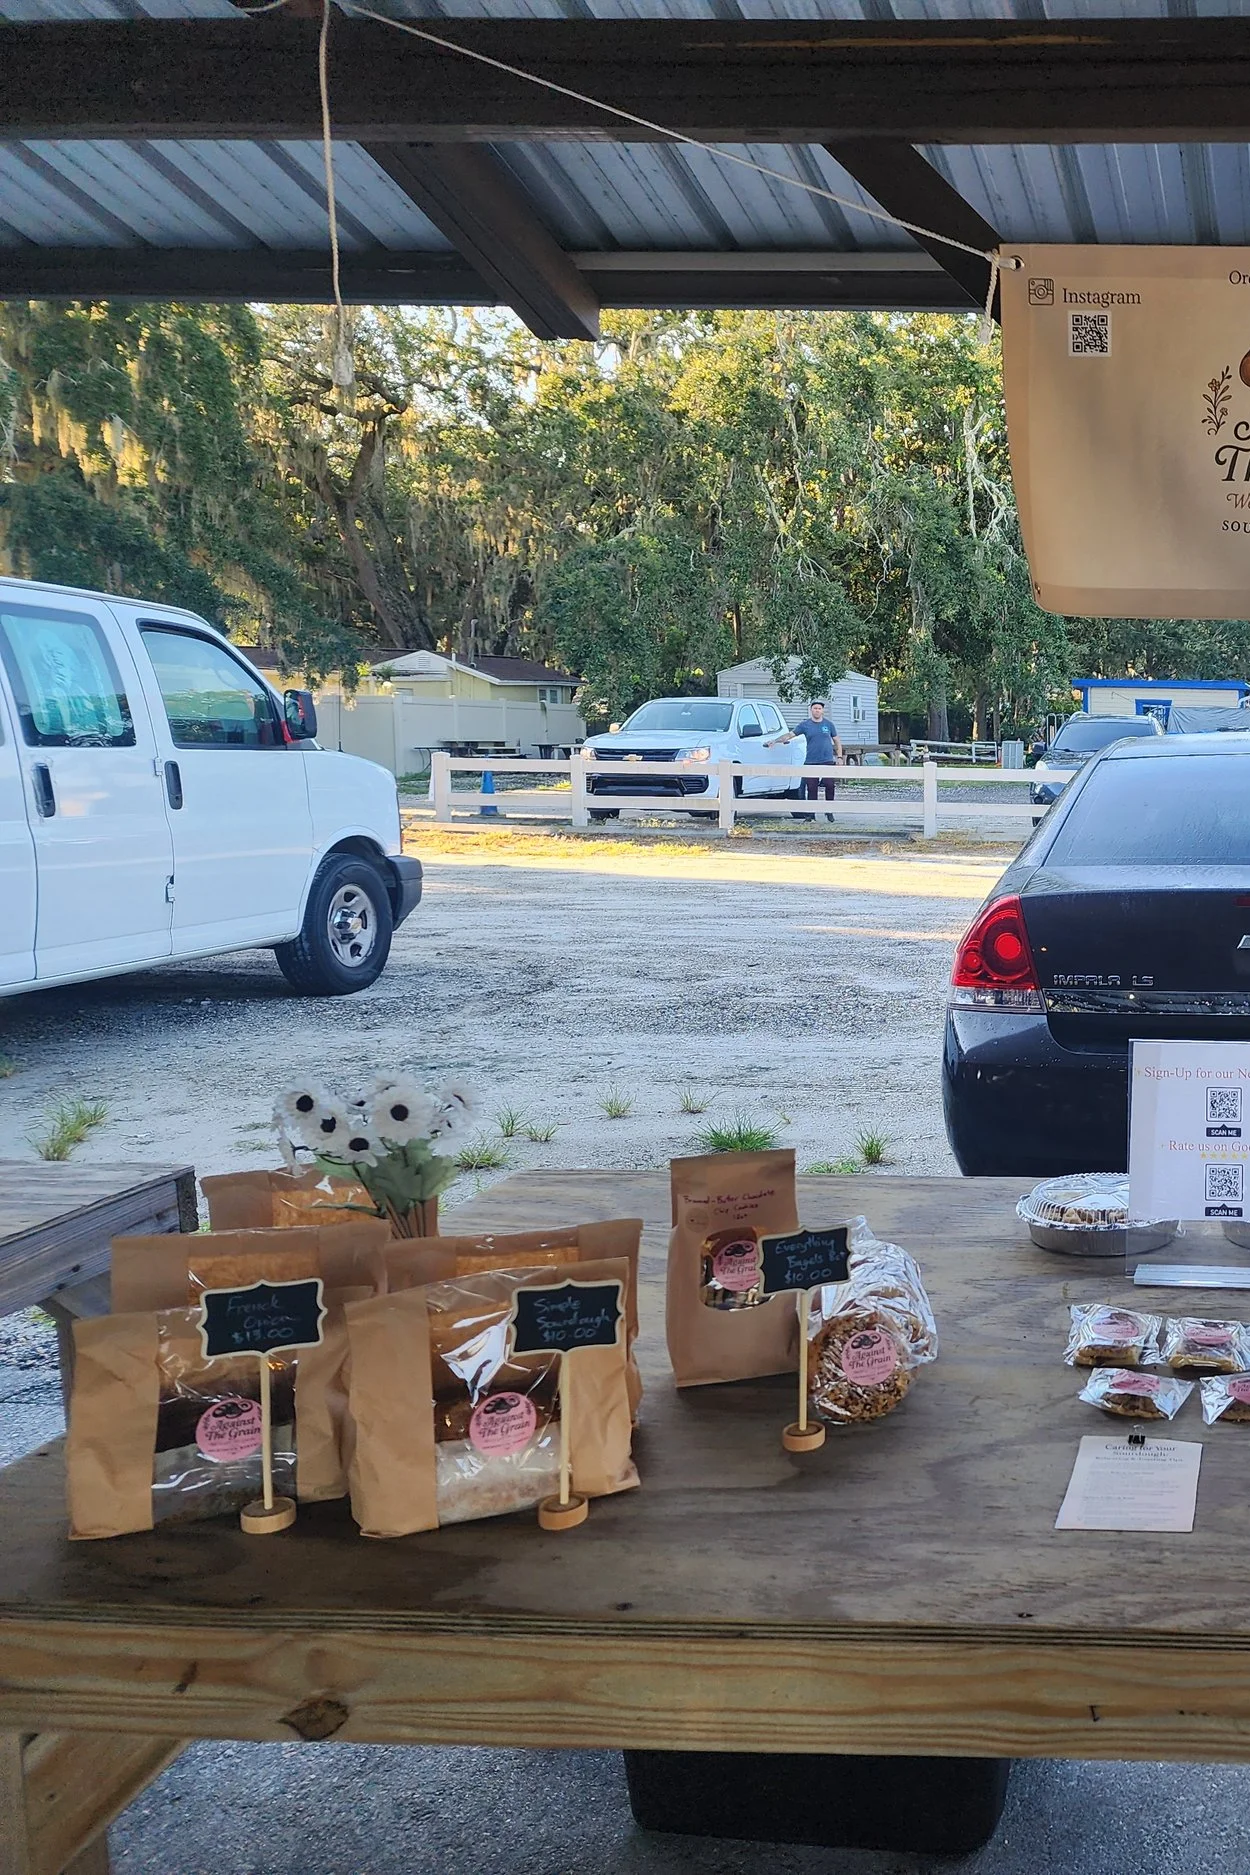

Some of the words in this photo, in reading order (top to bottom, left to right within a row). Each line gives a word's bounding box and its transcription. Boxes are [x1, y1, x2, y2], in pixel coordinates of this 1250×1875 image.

[1063, 288, 1141, 308] Instagram
[1053, 974, 1121, 986] IMPALA
[1132, 976, 1154, 986] LS
[1144, 1067, 1192, 1080] Sign-Up
[1196, 1067, 1212, 1078] for
[1215, 1071, 1234, 1079] our
[1169, 1140, 1194, 1151] Rate
[1198, 1143, 1210, 1151] us
[775, 1235, 835, 1254] Everything
[534, 1296, 581, 1313] Simple
[536, 1308, 610, 1330] Sourdough
[848, 1360, 864, 1369] The
[210, 1417, 255, 1431] Against
[205, 1431, 226, 1441] The
[228, 1426, 261, 1441] Grain
[479, 1427, 498, 1438] The
